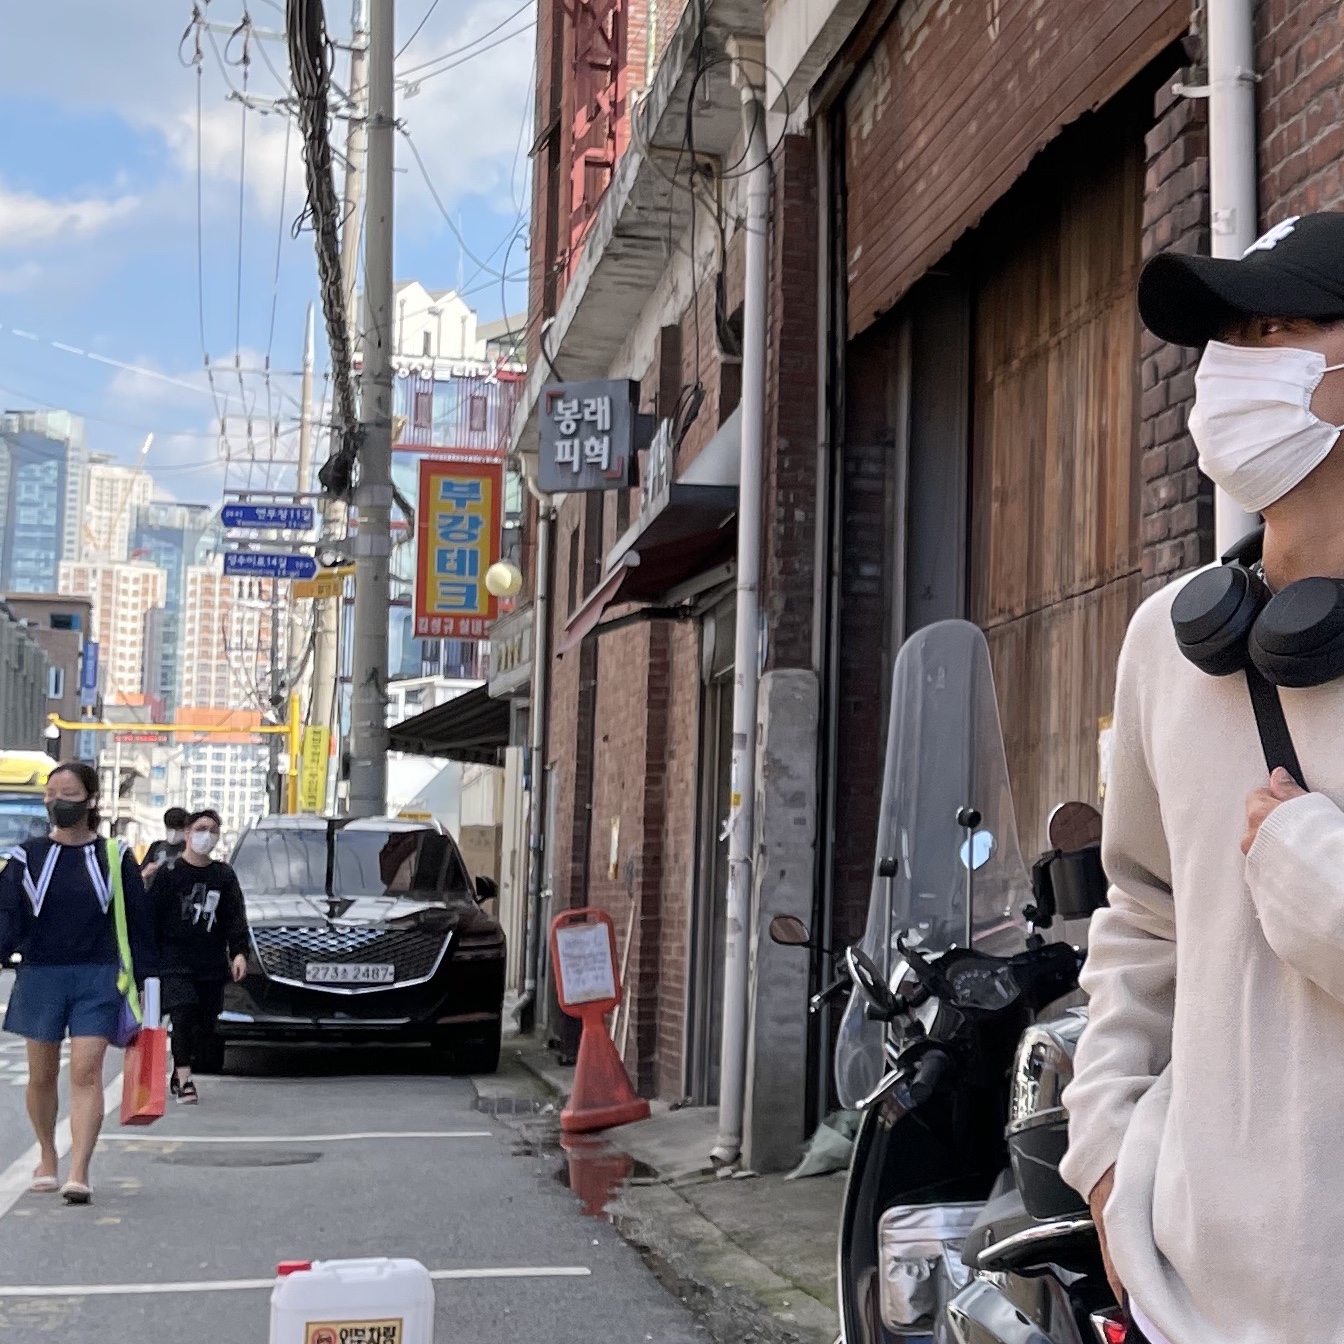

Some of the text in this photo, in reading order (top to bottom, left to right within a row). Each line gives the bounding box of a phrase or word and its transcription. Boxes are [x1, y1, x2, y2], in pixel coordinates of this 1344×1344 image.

[554, 395, 611, 434] 봉래
[554, 434, 610, 473] 피혁
[435, 478, 484, 612] 부강테크
